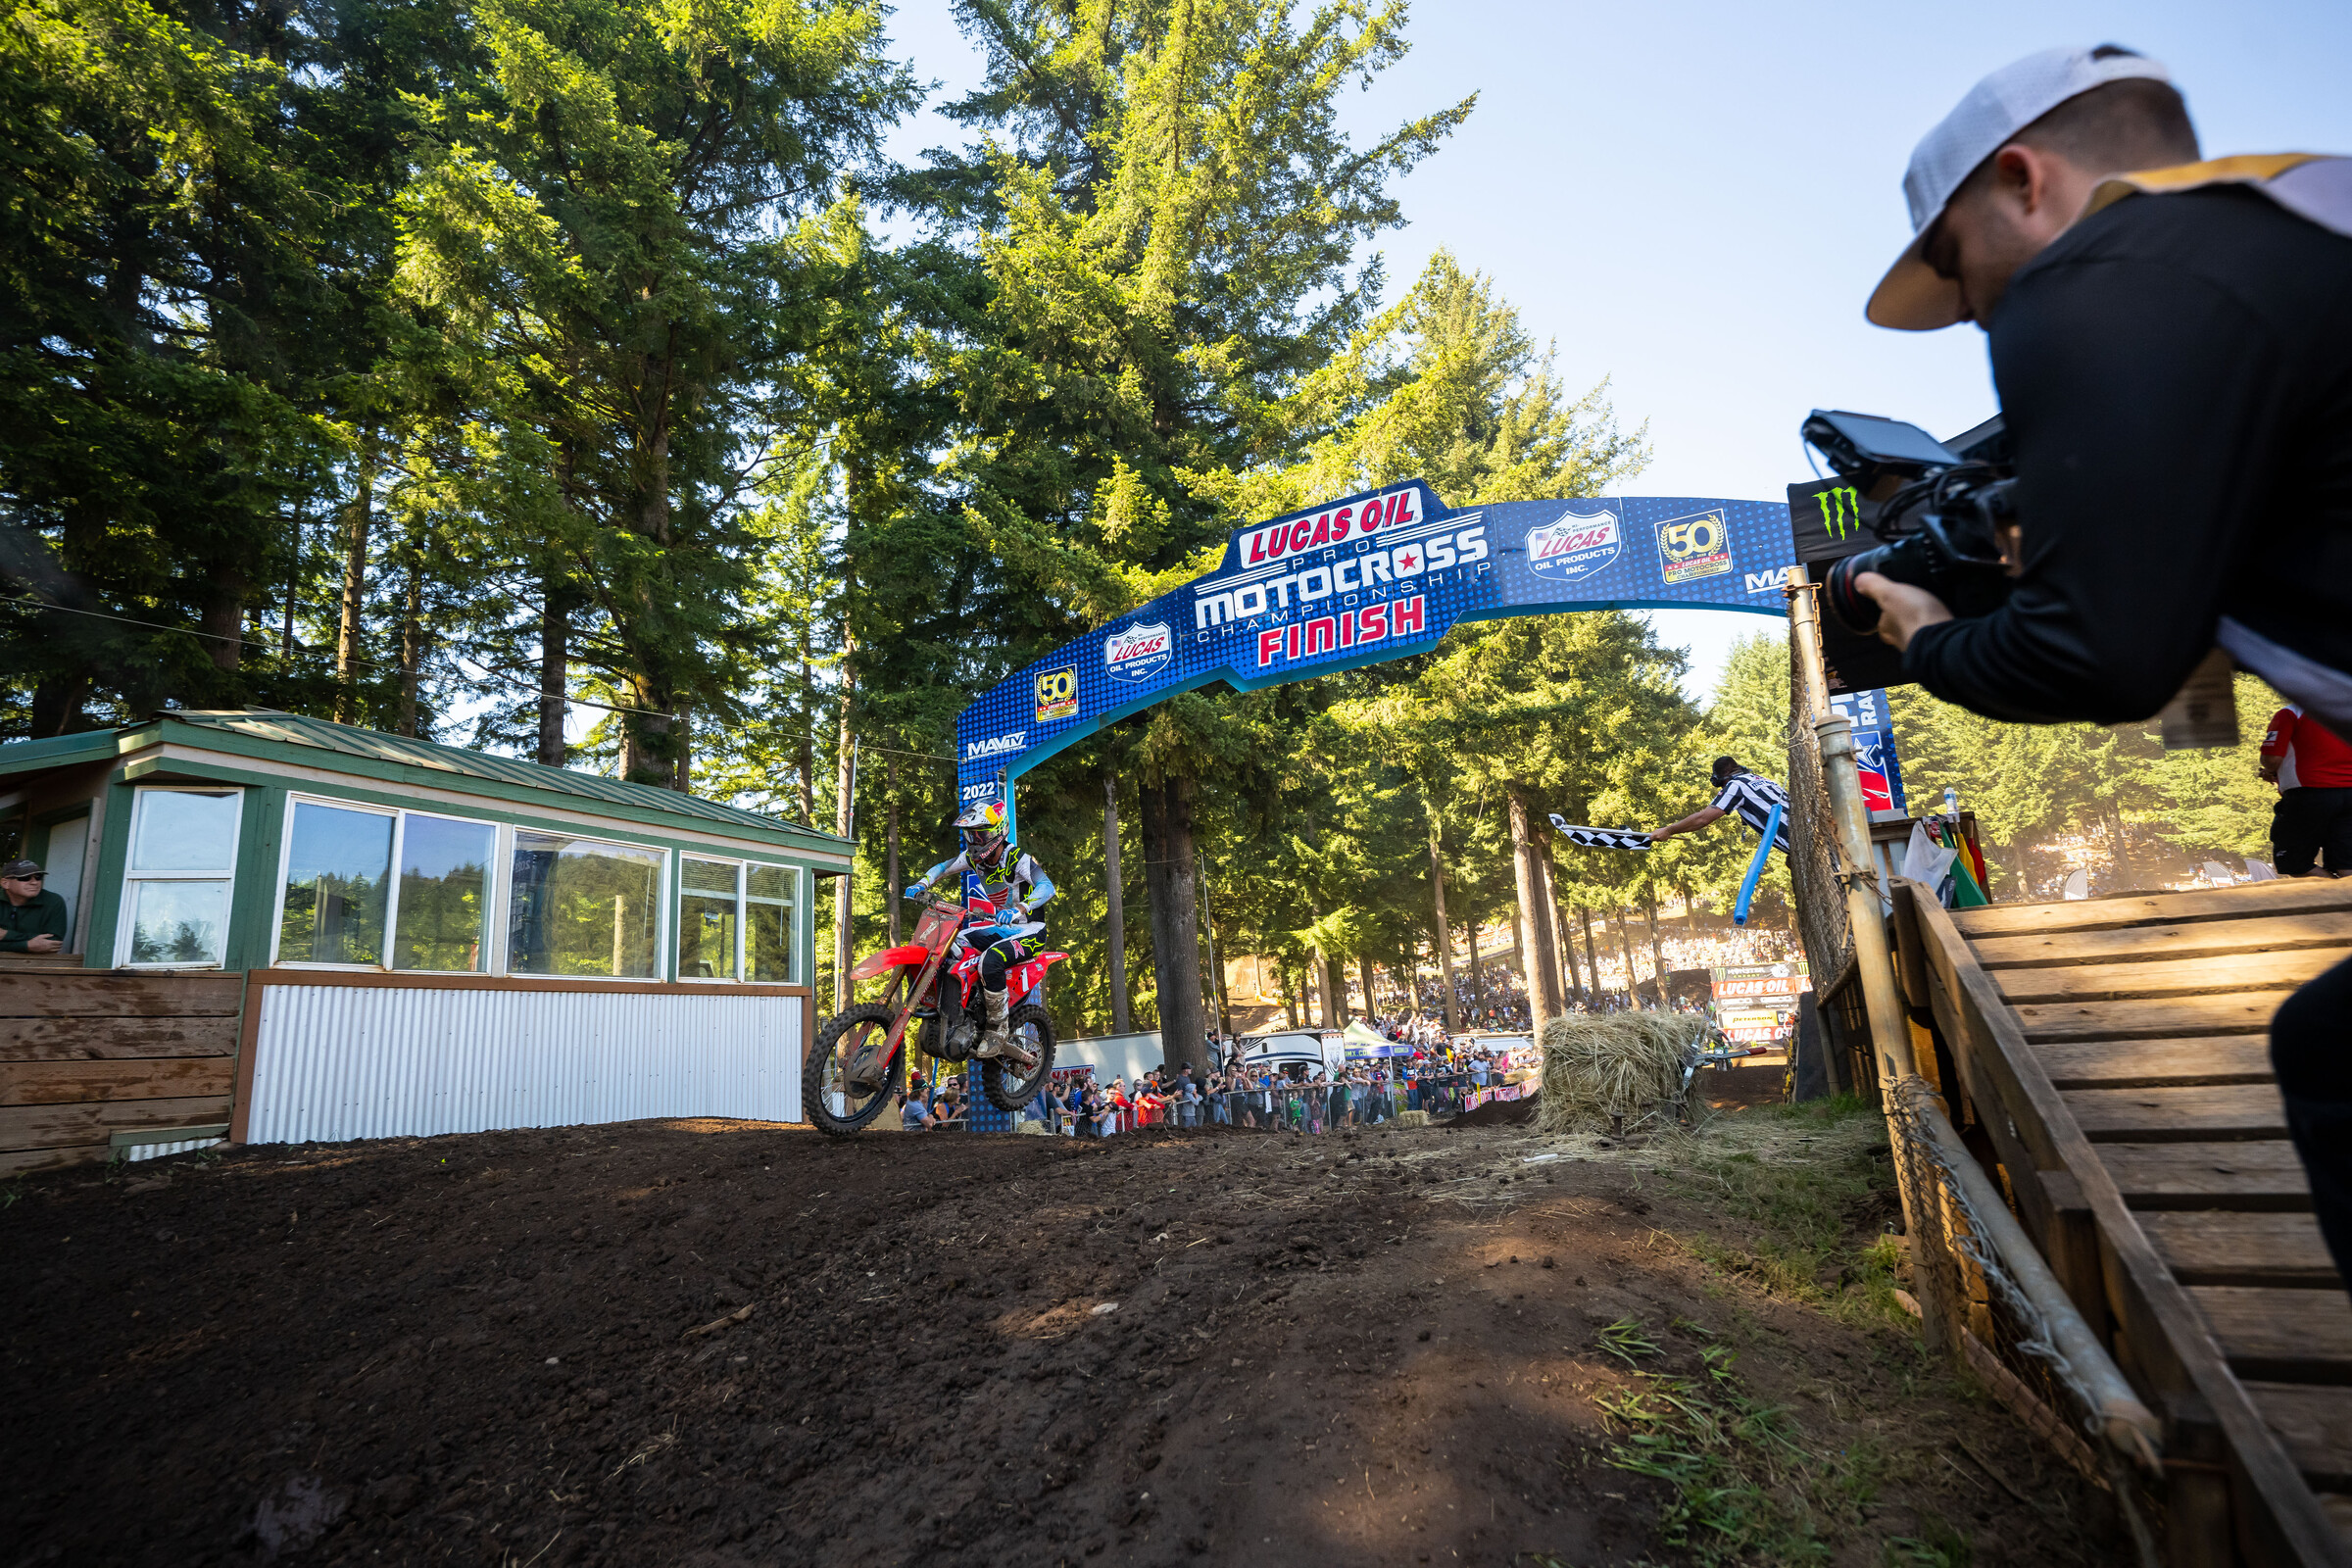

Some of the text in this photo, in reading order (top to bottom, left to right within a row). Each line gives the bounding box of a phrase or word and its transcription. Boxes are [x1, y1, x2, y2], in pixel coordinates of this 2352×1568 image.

[1248, 491, 1416, 564] LUCAS OIL
[1668, 519, 1719, 558] 50
[1293, 539, 1371, 571] PRO
[1538, 526, 1610, 559] LUCAS
[1535, 546, 1616, 571] OIL PRODUCTS
[1565, 564, 1590, 575] INC.
[1682, 559, 1701, 567] LUCAS
[1195, 525, 1490, 630] MOTOCROSS
[1198, 562, 1492, 643] CHAMPIONSHIP
[1257, 594, 1426, 668] FINISH
[1112, 636, 1165, 662] LUCAS
[1109, 653, 1168, 673] OIL PRODUCTS
[1131, 667, 1149, 677] INC.
[1042, 671, 1072, 702] 50
[962, 782, 996, 801] 2022
[1020, 966, 1030, 993] 1
[1718, 981, 1764, 996] LUCAS
[1766, 979, 1789, 993] OIL
[1727, 1028, 1772, 1042] LUCAS
